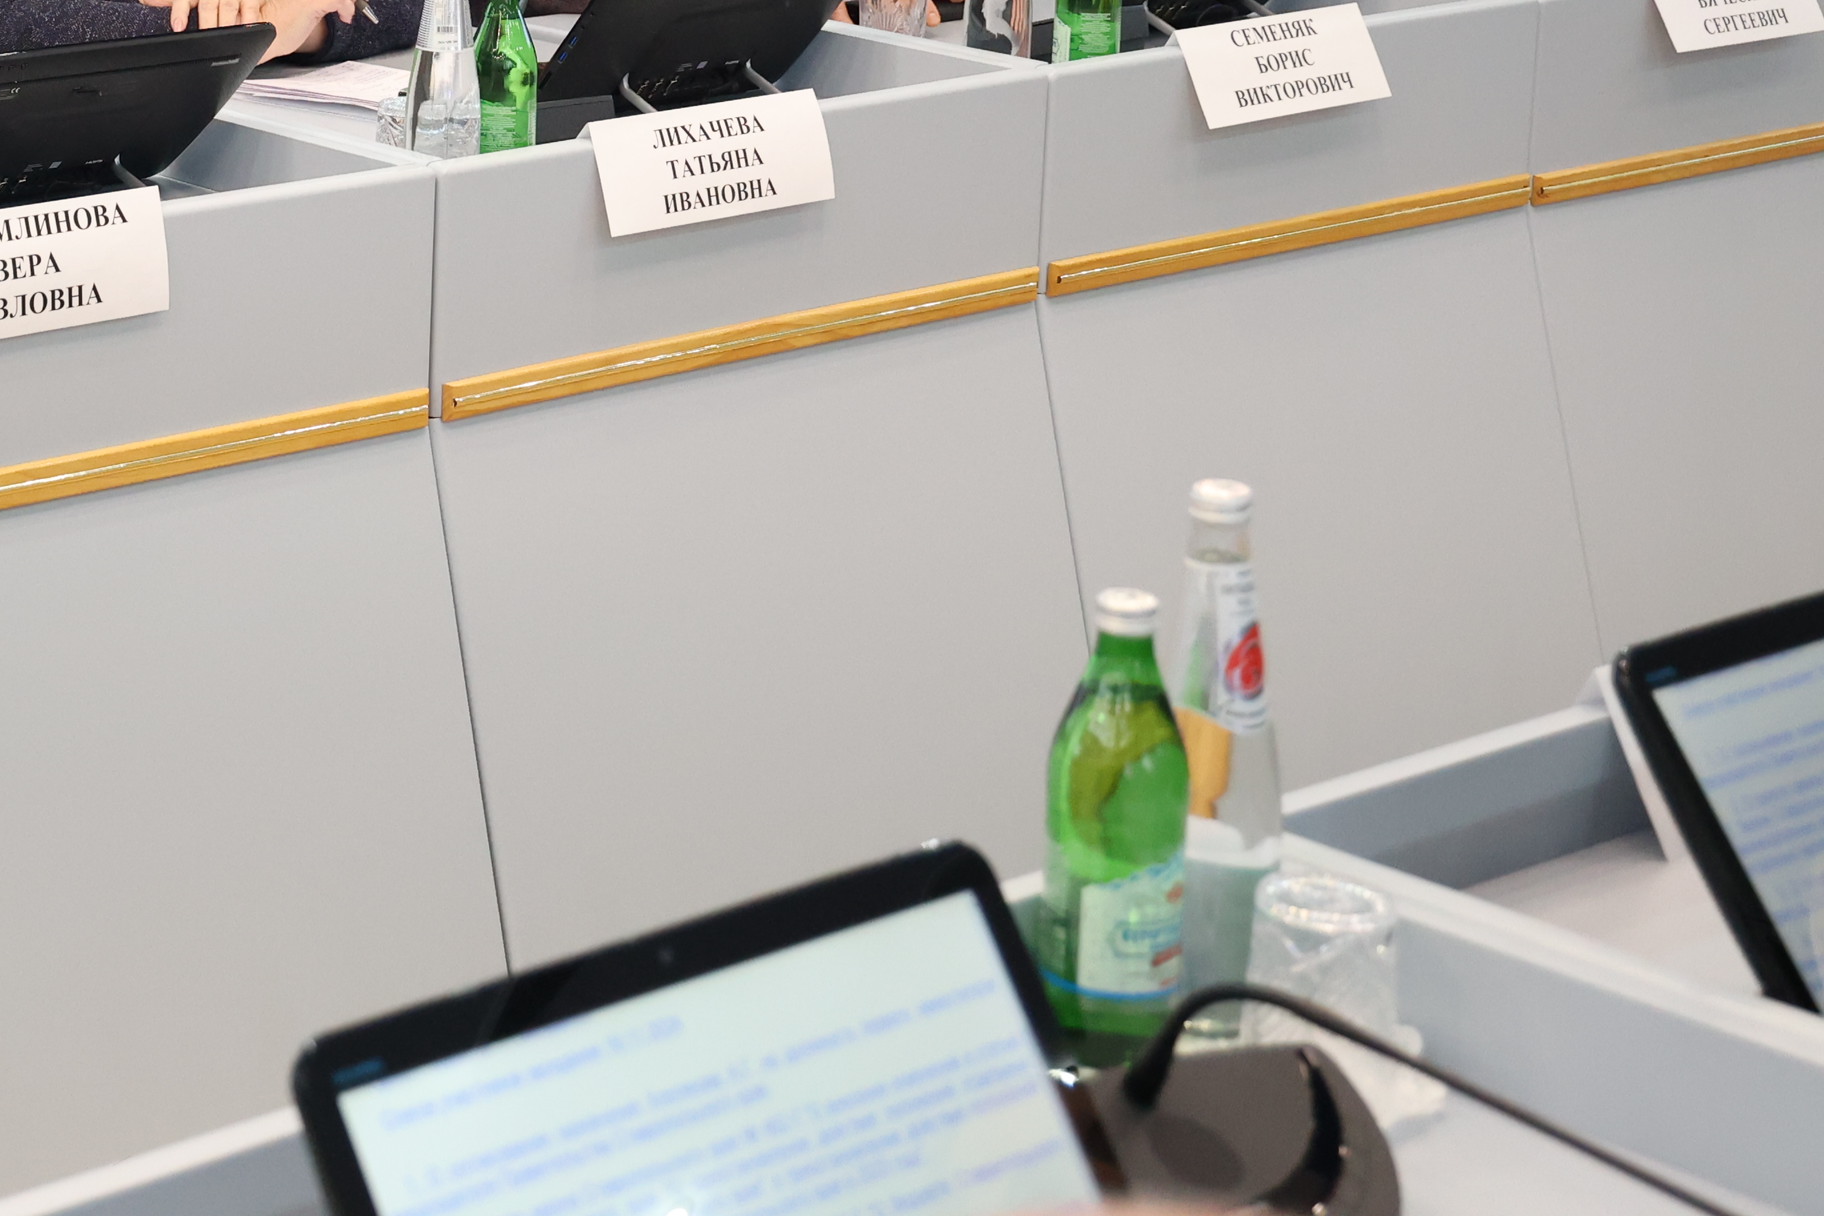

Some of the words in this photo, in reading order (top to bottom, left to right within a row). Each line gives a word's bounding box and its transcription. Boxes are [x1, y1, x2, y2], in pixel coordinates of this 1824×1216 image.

[1230, 19, 1317, 47] СЕМЕНЯК
[1703, 8, 1788, 34] СЕРГЕЕВИЧ
[1254, 49, 1313, 73] БОРИС
[1234, 72, 1353, 107] ВИКТОРОВИЧ
[652, 116, 764, 149] ЛИХАЧЕВА
[665, 148, 763, 179] ТАТЬЯНА
[663, 179, 777, 214] ИВАНОВНА
